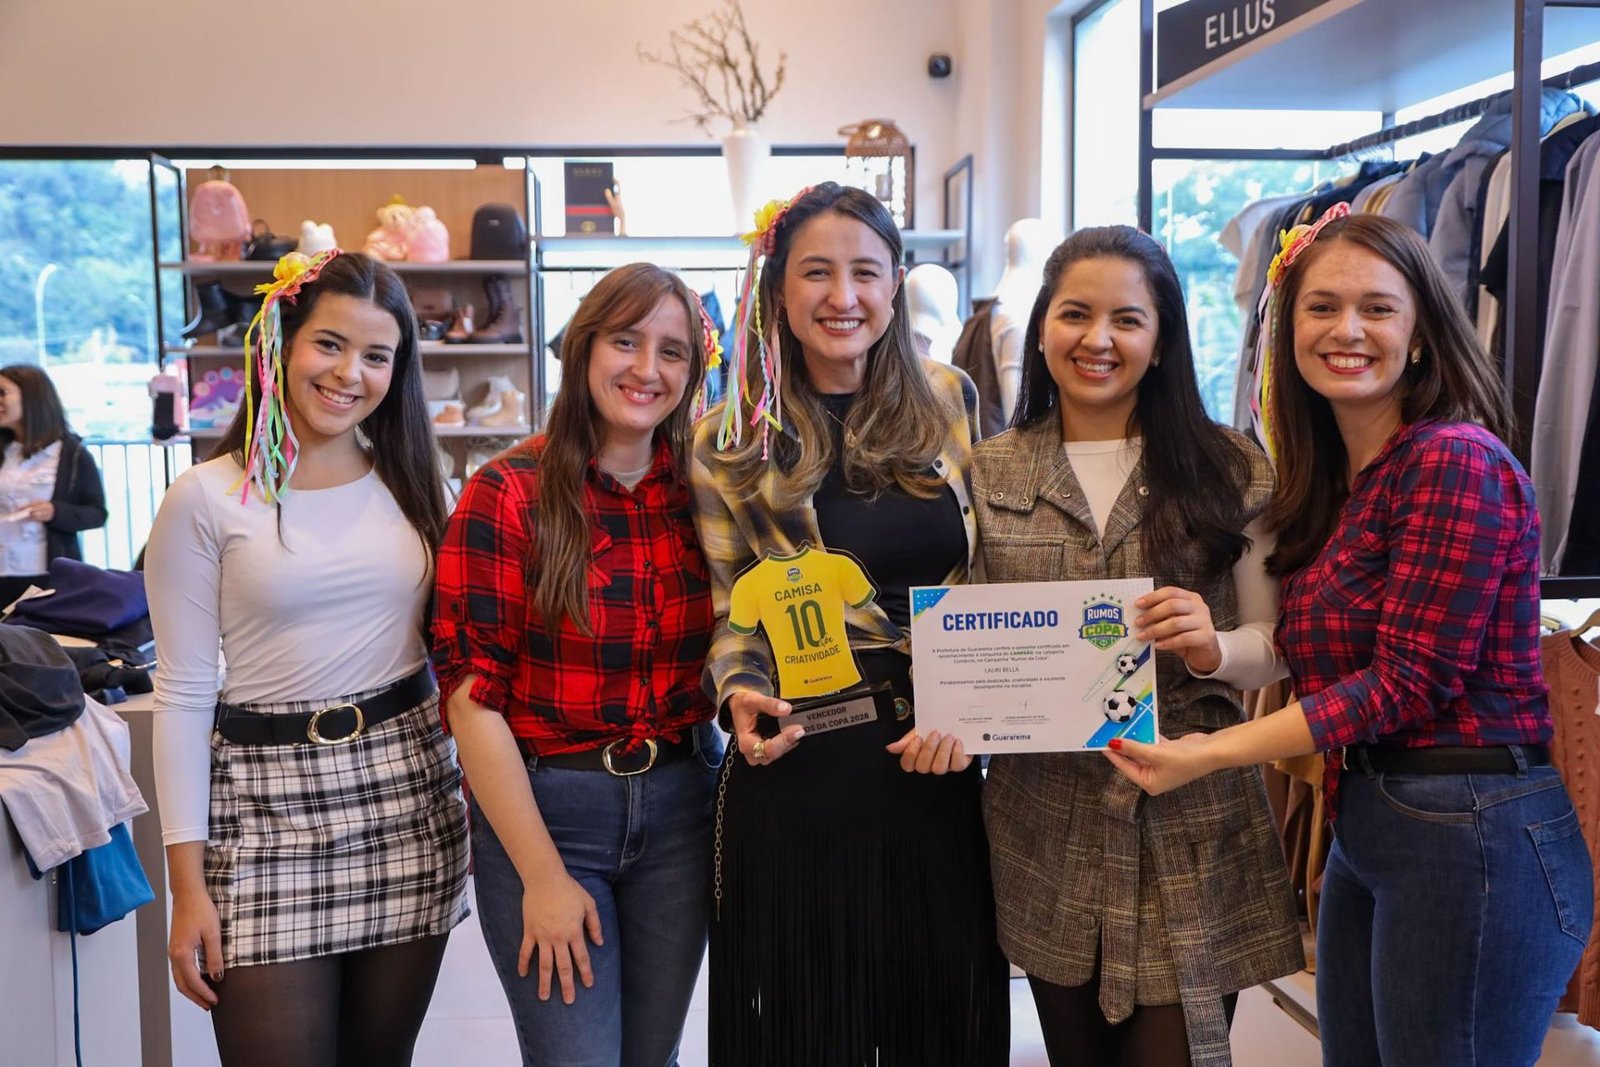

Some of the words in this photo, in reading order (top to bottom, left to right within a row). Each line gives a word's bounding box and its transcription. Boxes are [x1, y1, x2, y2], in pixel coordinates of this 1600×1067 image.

[1205, 0, 1275, 50] ELLUS
[774, 583, 823, 602] CAMISA
[943, 610, 1059, 631] CERTIFICADO
[1087, 608, 1119, 620] RUMOS
[785, 600, 826, 651] 10
[1085, 624, 1121, 635] COPA
[785, 644, 841, 665] CRIATIVIDADE
[806, 706, 847, 721] VENCEDOR
[816, 722, 827, 730] DA
[828, 716, 850, 728] COPA
[992, 733, 1031, 741] Guararema
